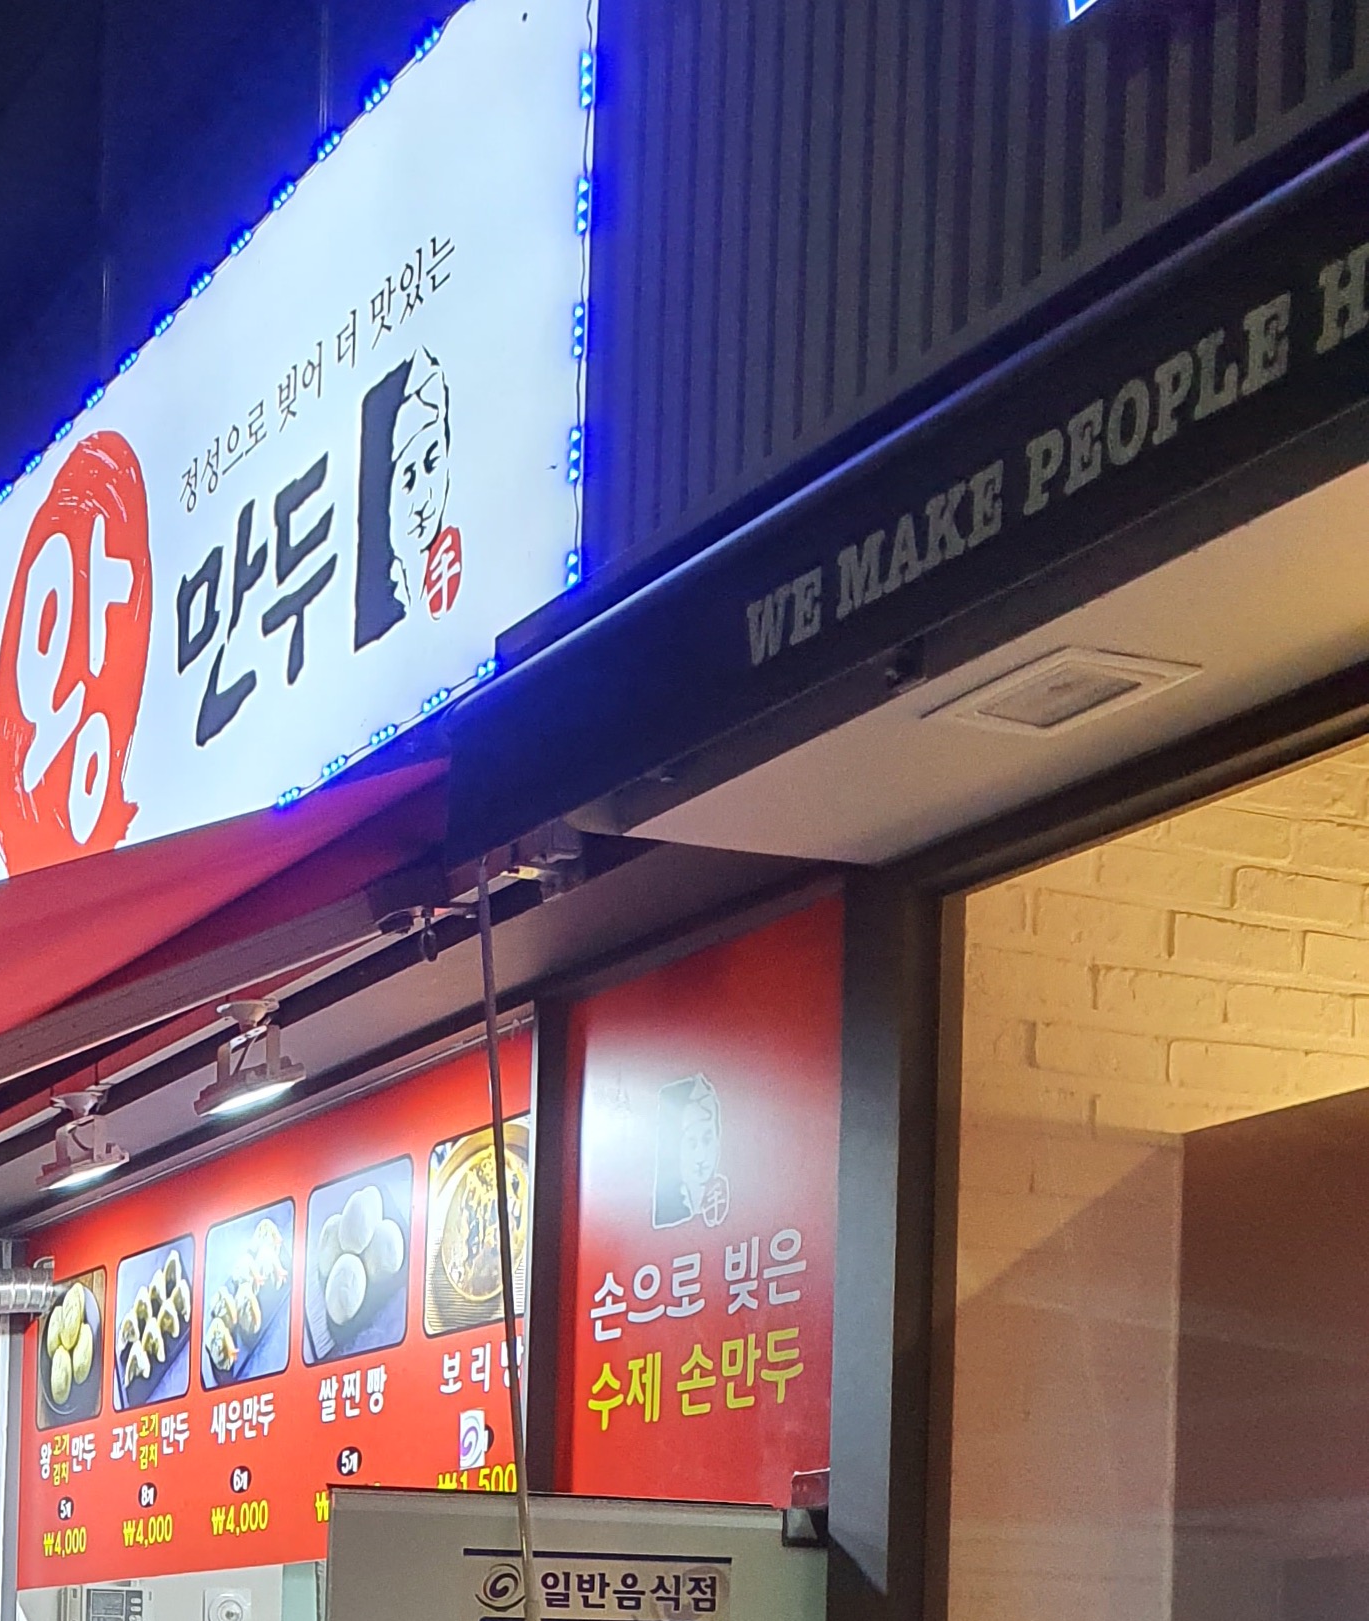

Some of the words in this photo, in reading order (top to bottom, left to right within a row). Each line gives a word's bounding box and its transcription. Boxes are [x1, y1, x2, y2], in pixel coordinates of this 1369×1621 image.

[180, 399, 268, 513] 정성으로
[336, 310, 358, 369] 더
[371, 236, 456, 350] 맛있는
[746, 566, 823, 667] WE
[835, 459, 1004, 621] MAKE
[1022, 291, 1292, 517] PEOPLE
[15, 516, 136, 846] 왕
[175, 450, 338, 748] 만두
[589, 1252, 707, 1342] 손으로
[318, 1364, 388, 1423] 쌀찐빵
[587, 1350, 663, 1432] 수제
[676, 1325, 806, 1418] 손만두
[138, 1412, 159, 1437] 고기
[161, 1411, 191, 1456] 만두
[209, 1391, 277, 1446] 새우만두
[39, 1442, 53, 1480] 왕
[52, 1433, 70, 1457] 고기
[71, 1432, 97, 1474] 만두
[52, 1461, 70, 1487] 김치
[138, 1442, 159, 1470] 김치
[437, 1462, 518, 1494] ₩1500
[123, 1514, 174, 1549] ₩4,000
[211, 1499, 270, 1538] ₩4,000
[43, 1526, 88, 1558] ₩4,000
[540, 1570, 718, 1614] 일반음식점
